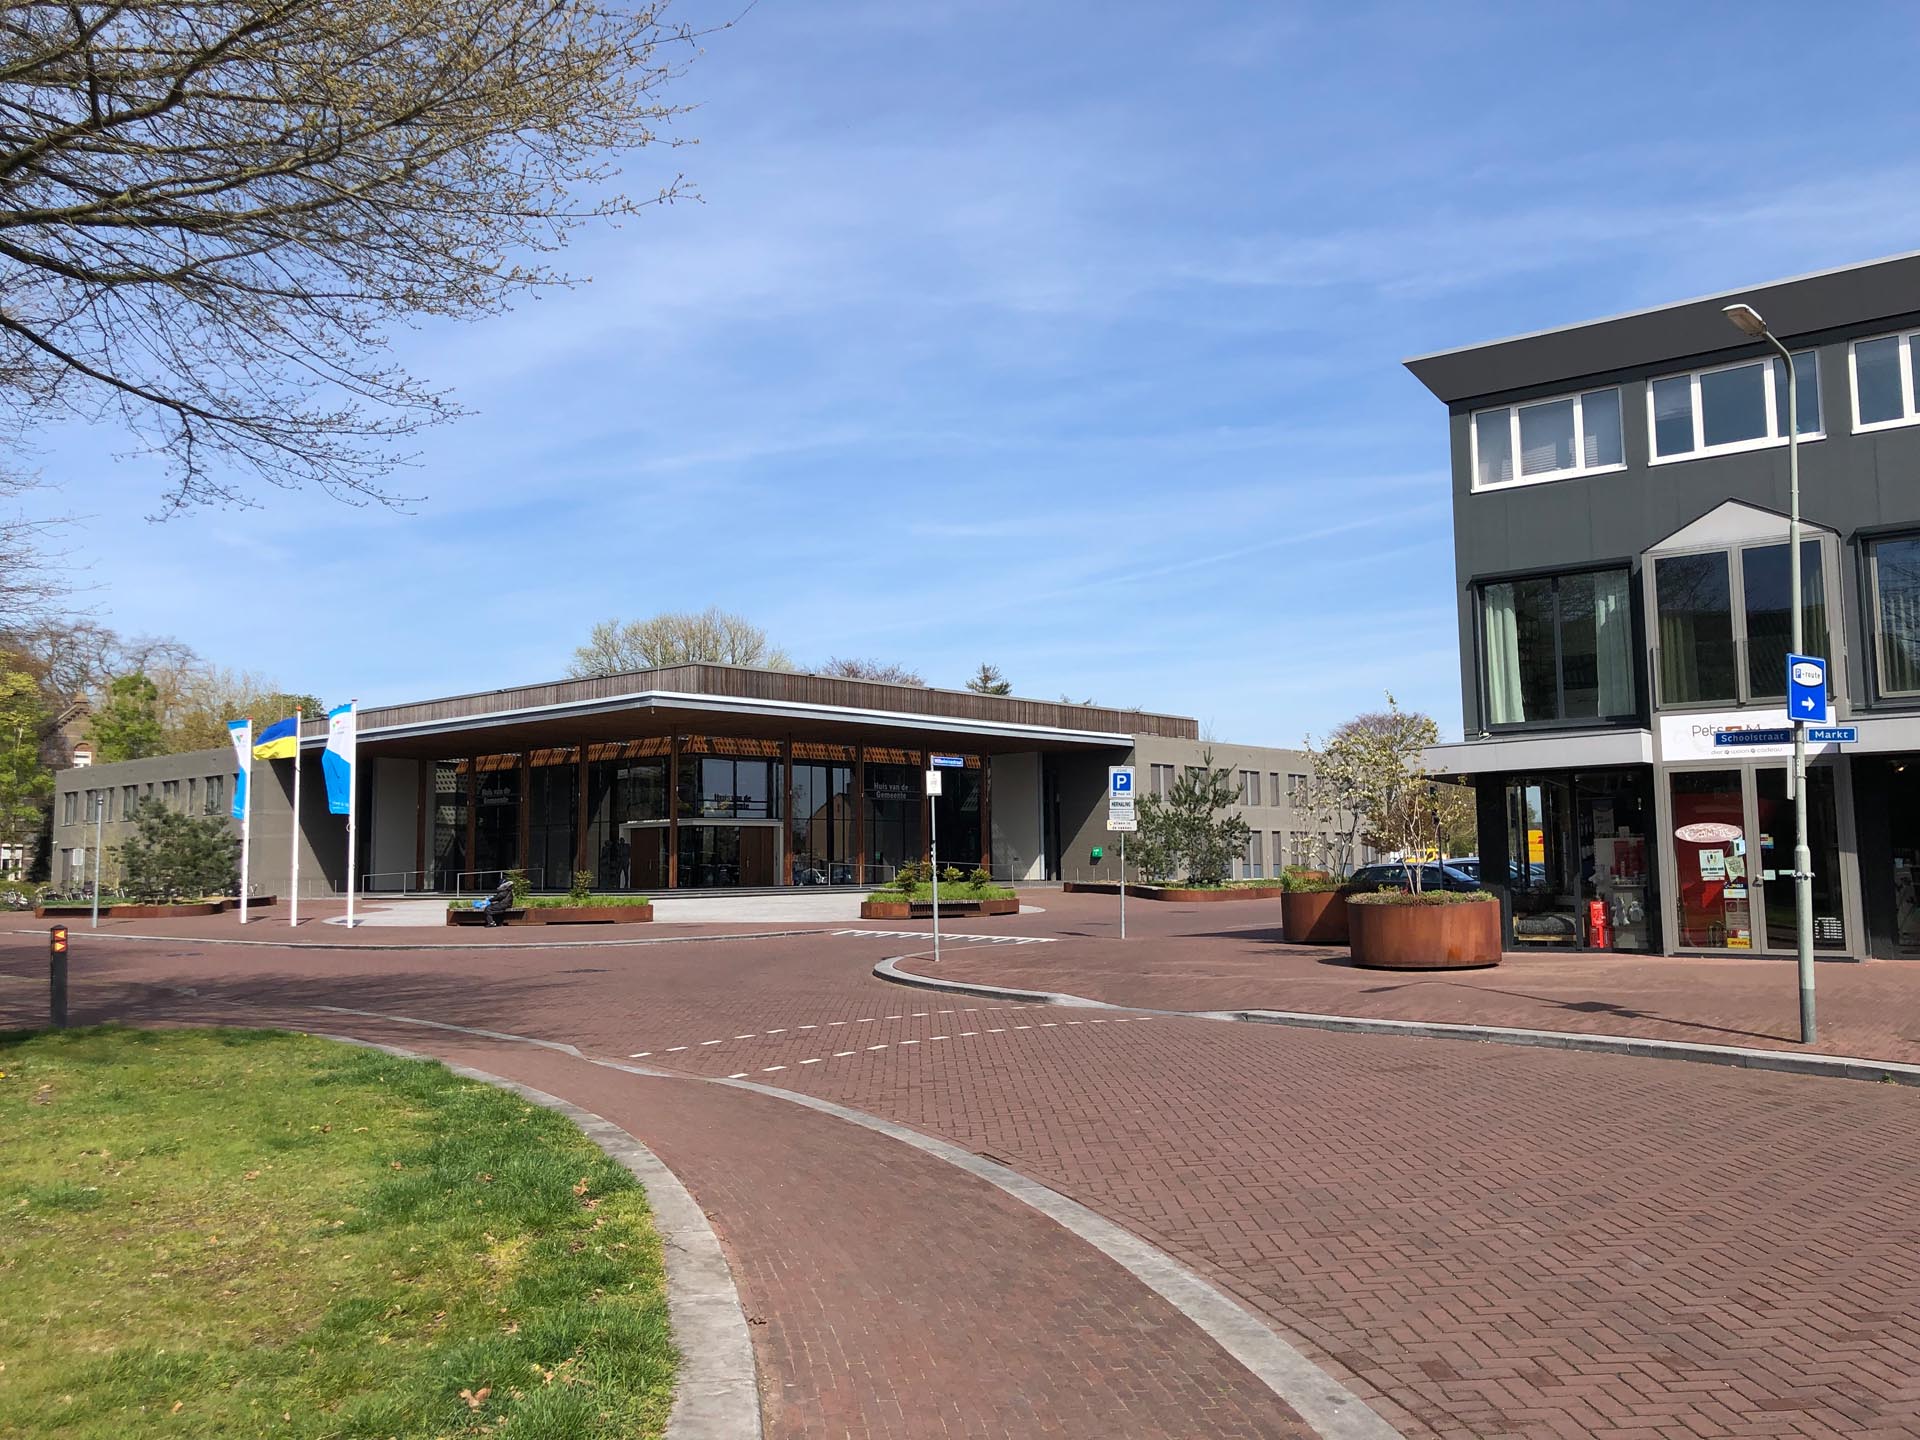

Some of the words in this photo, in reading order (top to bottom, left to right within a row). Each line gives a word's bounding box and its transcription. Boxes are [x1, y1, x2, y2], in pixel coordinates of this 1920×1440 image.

[1692, 724, 1724, 737] Pets
[1814, 730, 1849, 740] Markt
[1721, 732, 1784, 743] Schoolstraat
[873, 782, 887, 790] Huis
[1116, 775, 1127, 789] P
[876, 790, 907, 799] Gemeente
